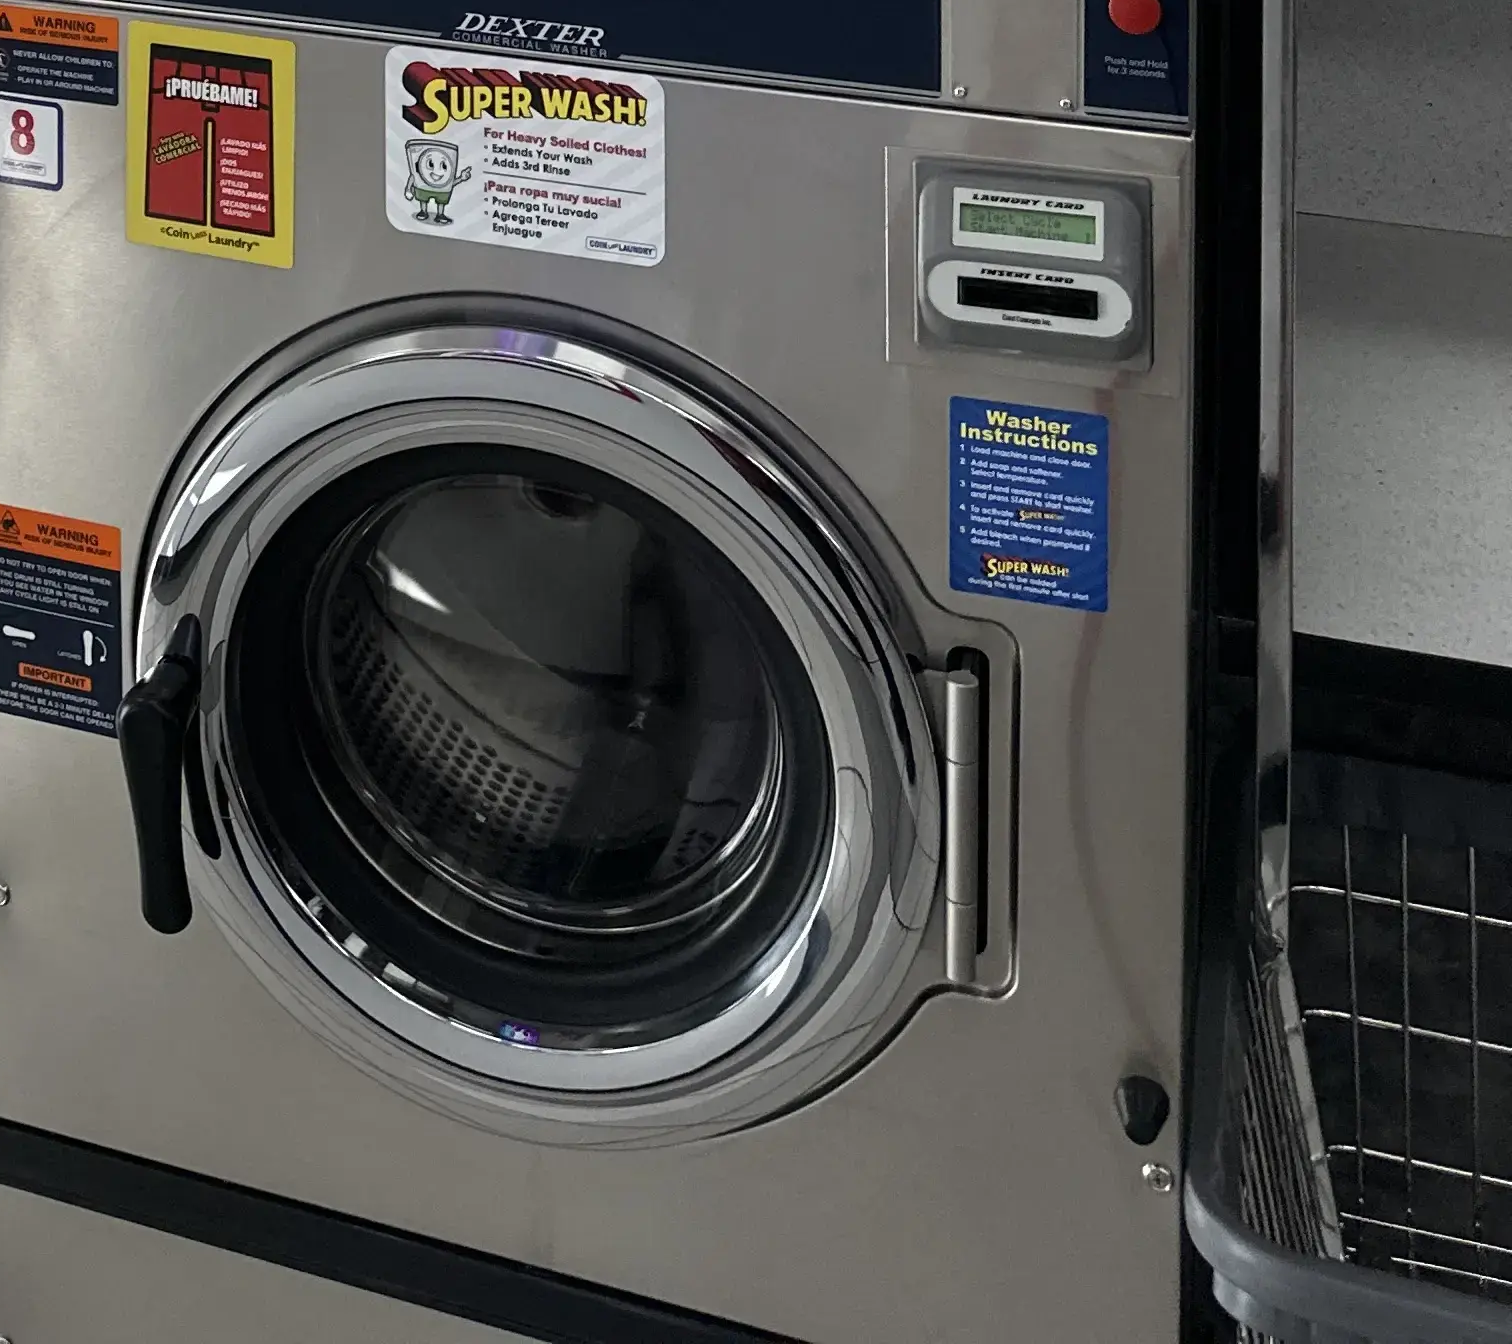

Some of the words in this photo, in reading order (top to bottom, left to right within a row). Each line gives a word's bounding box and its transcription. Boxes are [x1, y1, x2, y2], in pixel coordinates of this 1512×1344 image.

[33, 15, 96, 34] WARNING
[456, 12, 605, 48] DEXTER
[452, 31, 542, 52] COMMERCIAL
[549, 40, 609, 59] WASHER
[1107, 65, 1118, 75] for
[1120, 67, 1127, 76] 3
[1128, 68, 1166, 79] seconds
[164, 76, 259, 109] ¡PRUÉBAME!
[422, 77, 534, 135] SUPER
[540, 86, 648, 127] WASH!
[9, 108, 36, 157] 8
[483, 127, 505, 141] For
[506, 130, 548, 148] Heavy
[549, 135, 590, 152] Soiled
[592, 141, 648, 159] Clothes!
[152, 134, 198, 156] LAVADORA
[154, 143, 202, 164] COMERCIAL
[491, 143, 534, 159] Extends
[535, 149, 561, 162] Your
[563, 153, 593, 166] Wash
[491, 156, 521, 170] Adds
[522, 161, 541, 174] 3rd
[542, 163, 572, 177] Rinse
[483, 179, 517, 195] ¡Para
[519, 187, 549, 200] ropa
[551, 191, 580, 206] muy
[582, 194, 622, 210] sucia!
[971, 192, 1041, 207] LAUNDRY
[1044, 199, 1086, 211] CARD
[491, 196, 541, 214] Prolonga
[542, 202, 555, 215] Tu
[557, 204, 599, 221] Lavado
[491, 209, 534, 226] Agrega
[534, 215, 570, 231] Tereer
[491, 222, 544, 240] Enjuague
[1022, 213, 1063, 230] Cycle
[589, 238, 609, 250] COIN
[618, 242, 654, 257] LAUNDRY
[980, 267, 1033, 280] INSERT
[1034, 273, 1075, 285] CARD
[985, 409, 1072, 436] Washer
[959, 422, 1099, 456] Instructions
[36, 523, 99, 547] WARNING
[987, 557, 1029, 579] SUPER
[1030, 562, 1071, 577] WASH!
[22, 665, 87, 689] IMPORTANT
